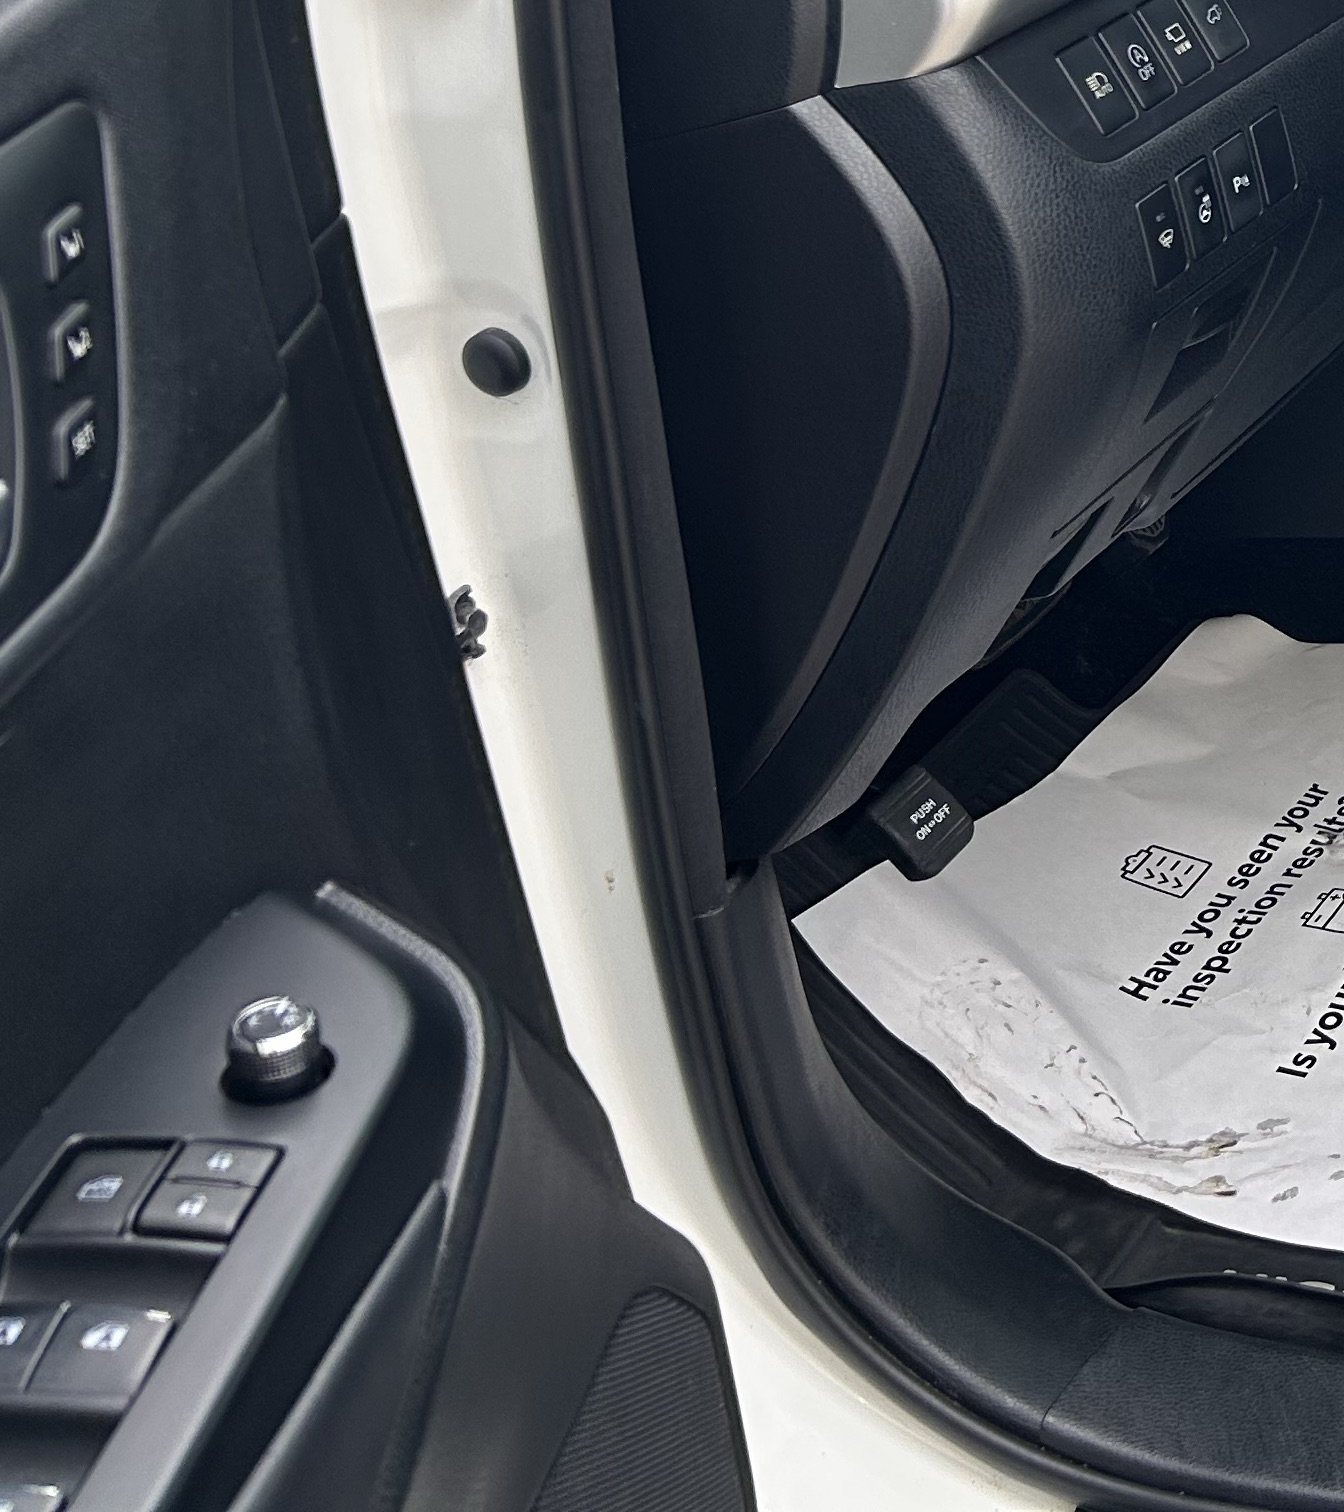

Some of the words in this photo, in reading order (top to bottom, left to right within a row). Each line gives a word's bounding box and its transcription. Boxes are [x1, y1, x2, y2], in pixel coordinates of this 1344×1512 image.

[910, 798, 936, 824] PUSH
[916, 824, 931, 840] ON
[933, 803, 950, 823] OFF
[1119, 941, 1194, 1001] Have
[1182, 893, 1237, 938] you
[1227, 834, 1287, 889] seen
[1274, 783, 1329, 832] your
[1162, 883, 1293, 1008] inspection
[1276, 1052, 1317, 1078] Is
